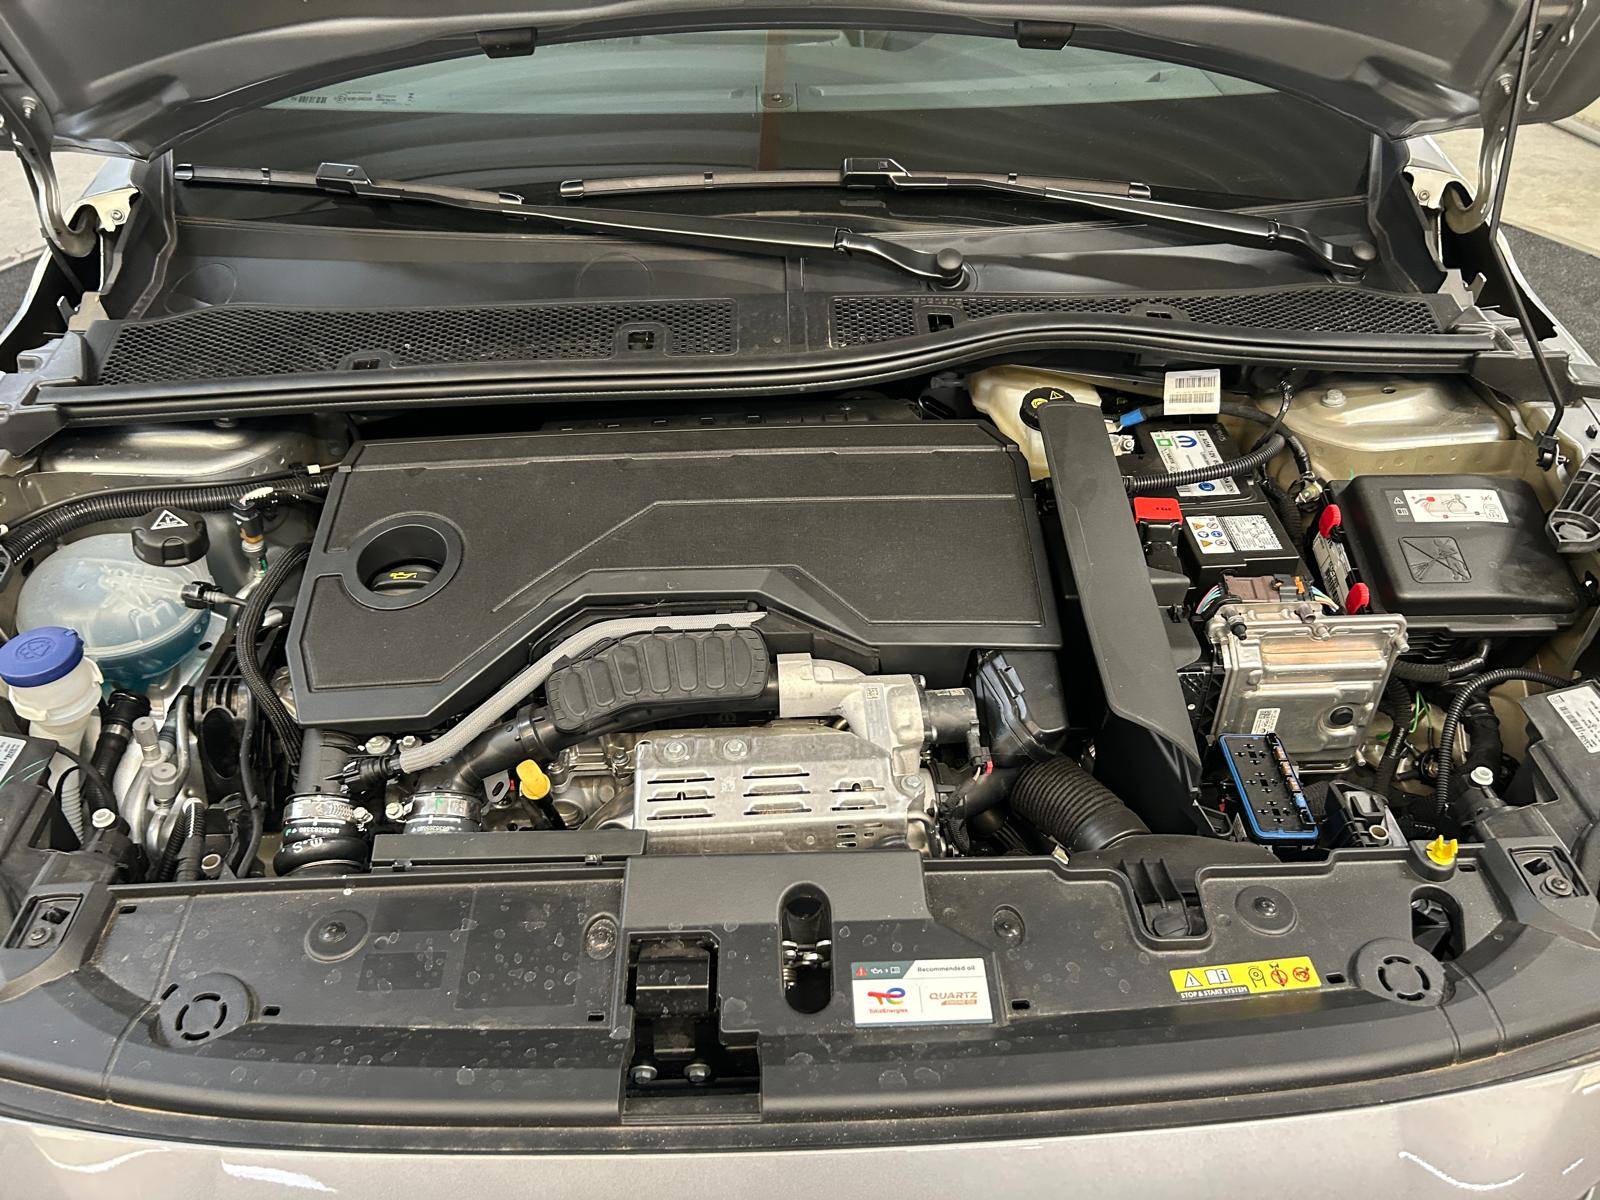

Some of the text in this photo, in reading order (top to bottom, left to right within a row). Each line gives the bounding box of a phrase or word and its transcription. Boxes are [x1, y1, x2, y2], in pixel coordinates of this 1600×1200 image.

[917, 965, 966, 973] Recommended
[929, 991, 977, 1000] QUARTZ
[1180, 991, 1198, 999] STOP
[1203, 988, 1223, 996] START
[1223, 986, 1248, 994] SYSTEM
